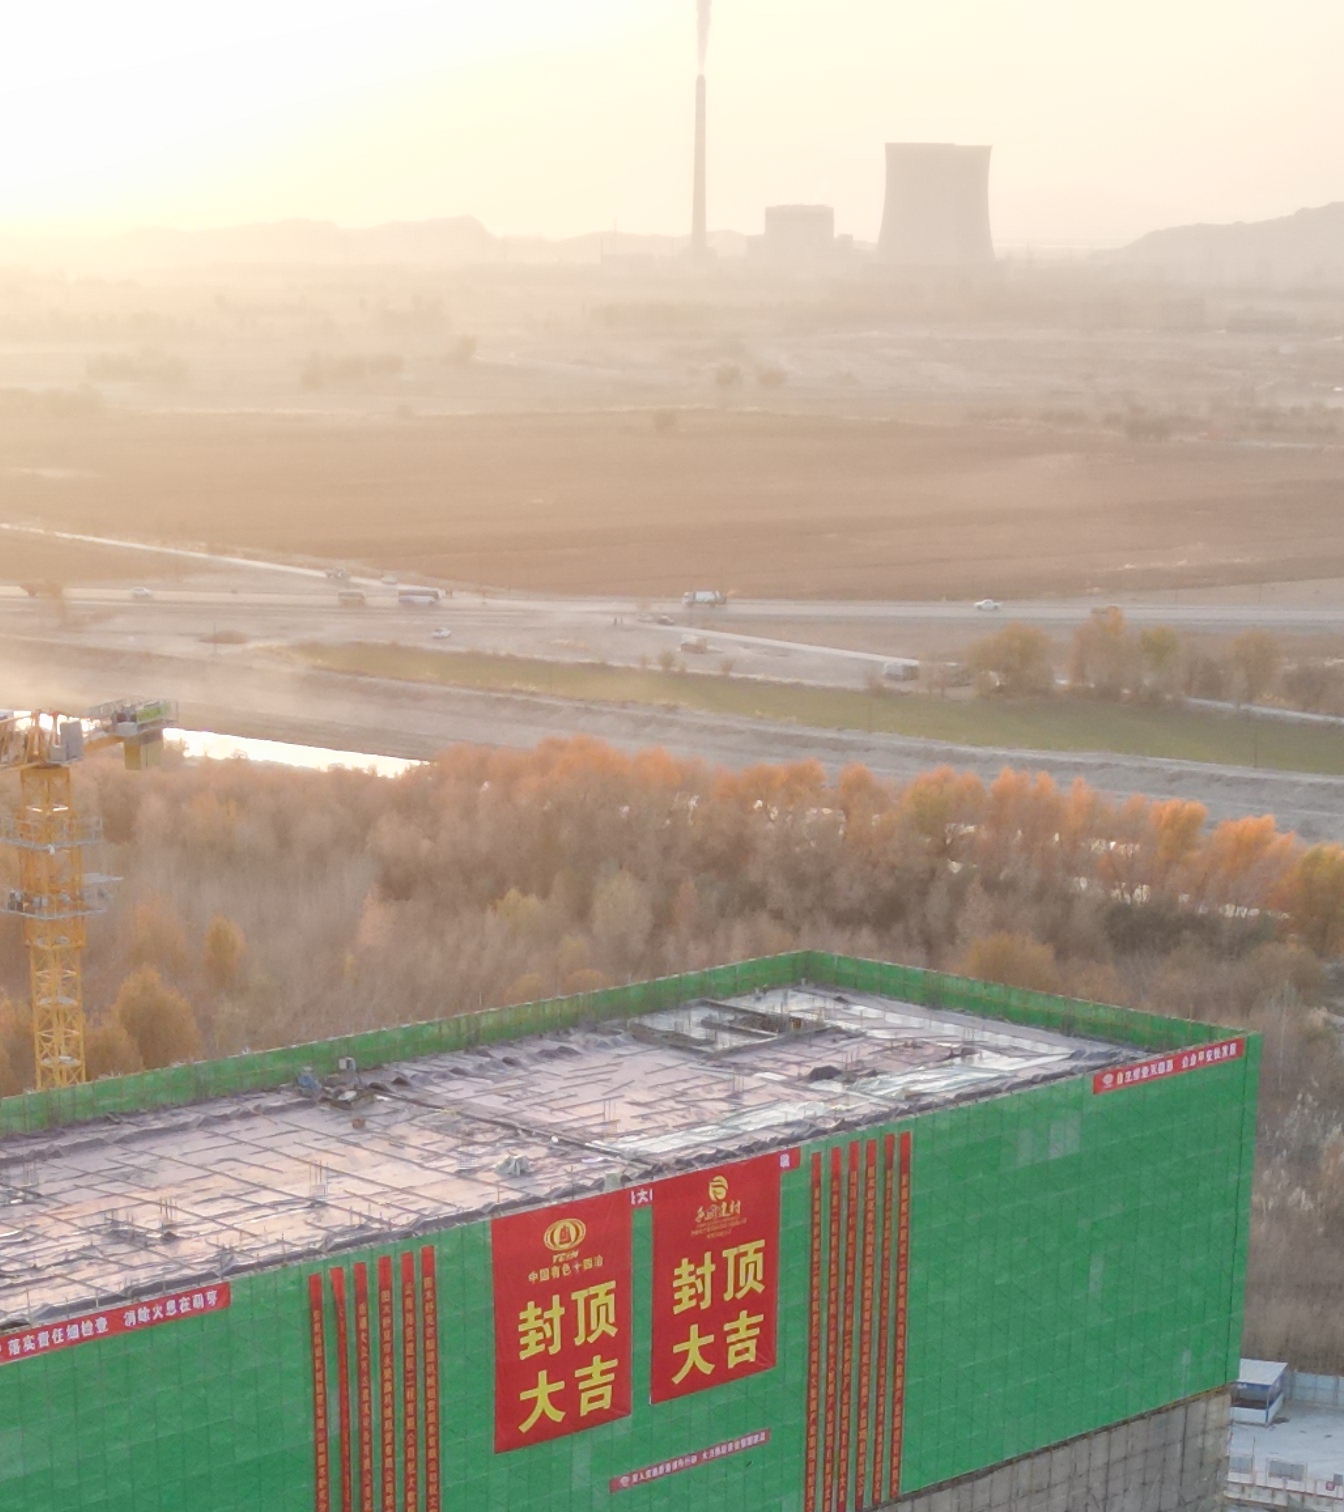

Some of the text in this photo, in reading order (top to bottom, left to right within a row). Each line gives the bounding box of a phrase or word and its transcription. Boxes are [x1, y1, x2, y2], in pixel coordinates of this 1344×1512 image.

[528, 1254, 603, 1283] 中国有色十四冶
[672, 1239, 766, 1316] 封顶
[8, 1289, 218, 1356] 落实责任细检查 消除火患在萌芽
[518, 1280, 619, 1361] 封顶
[672, 1309, 765, 1385] 大吉
[518, 1358, 619, 1435] 大吉
